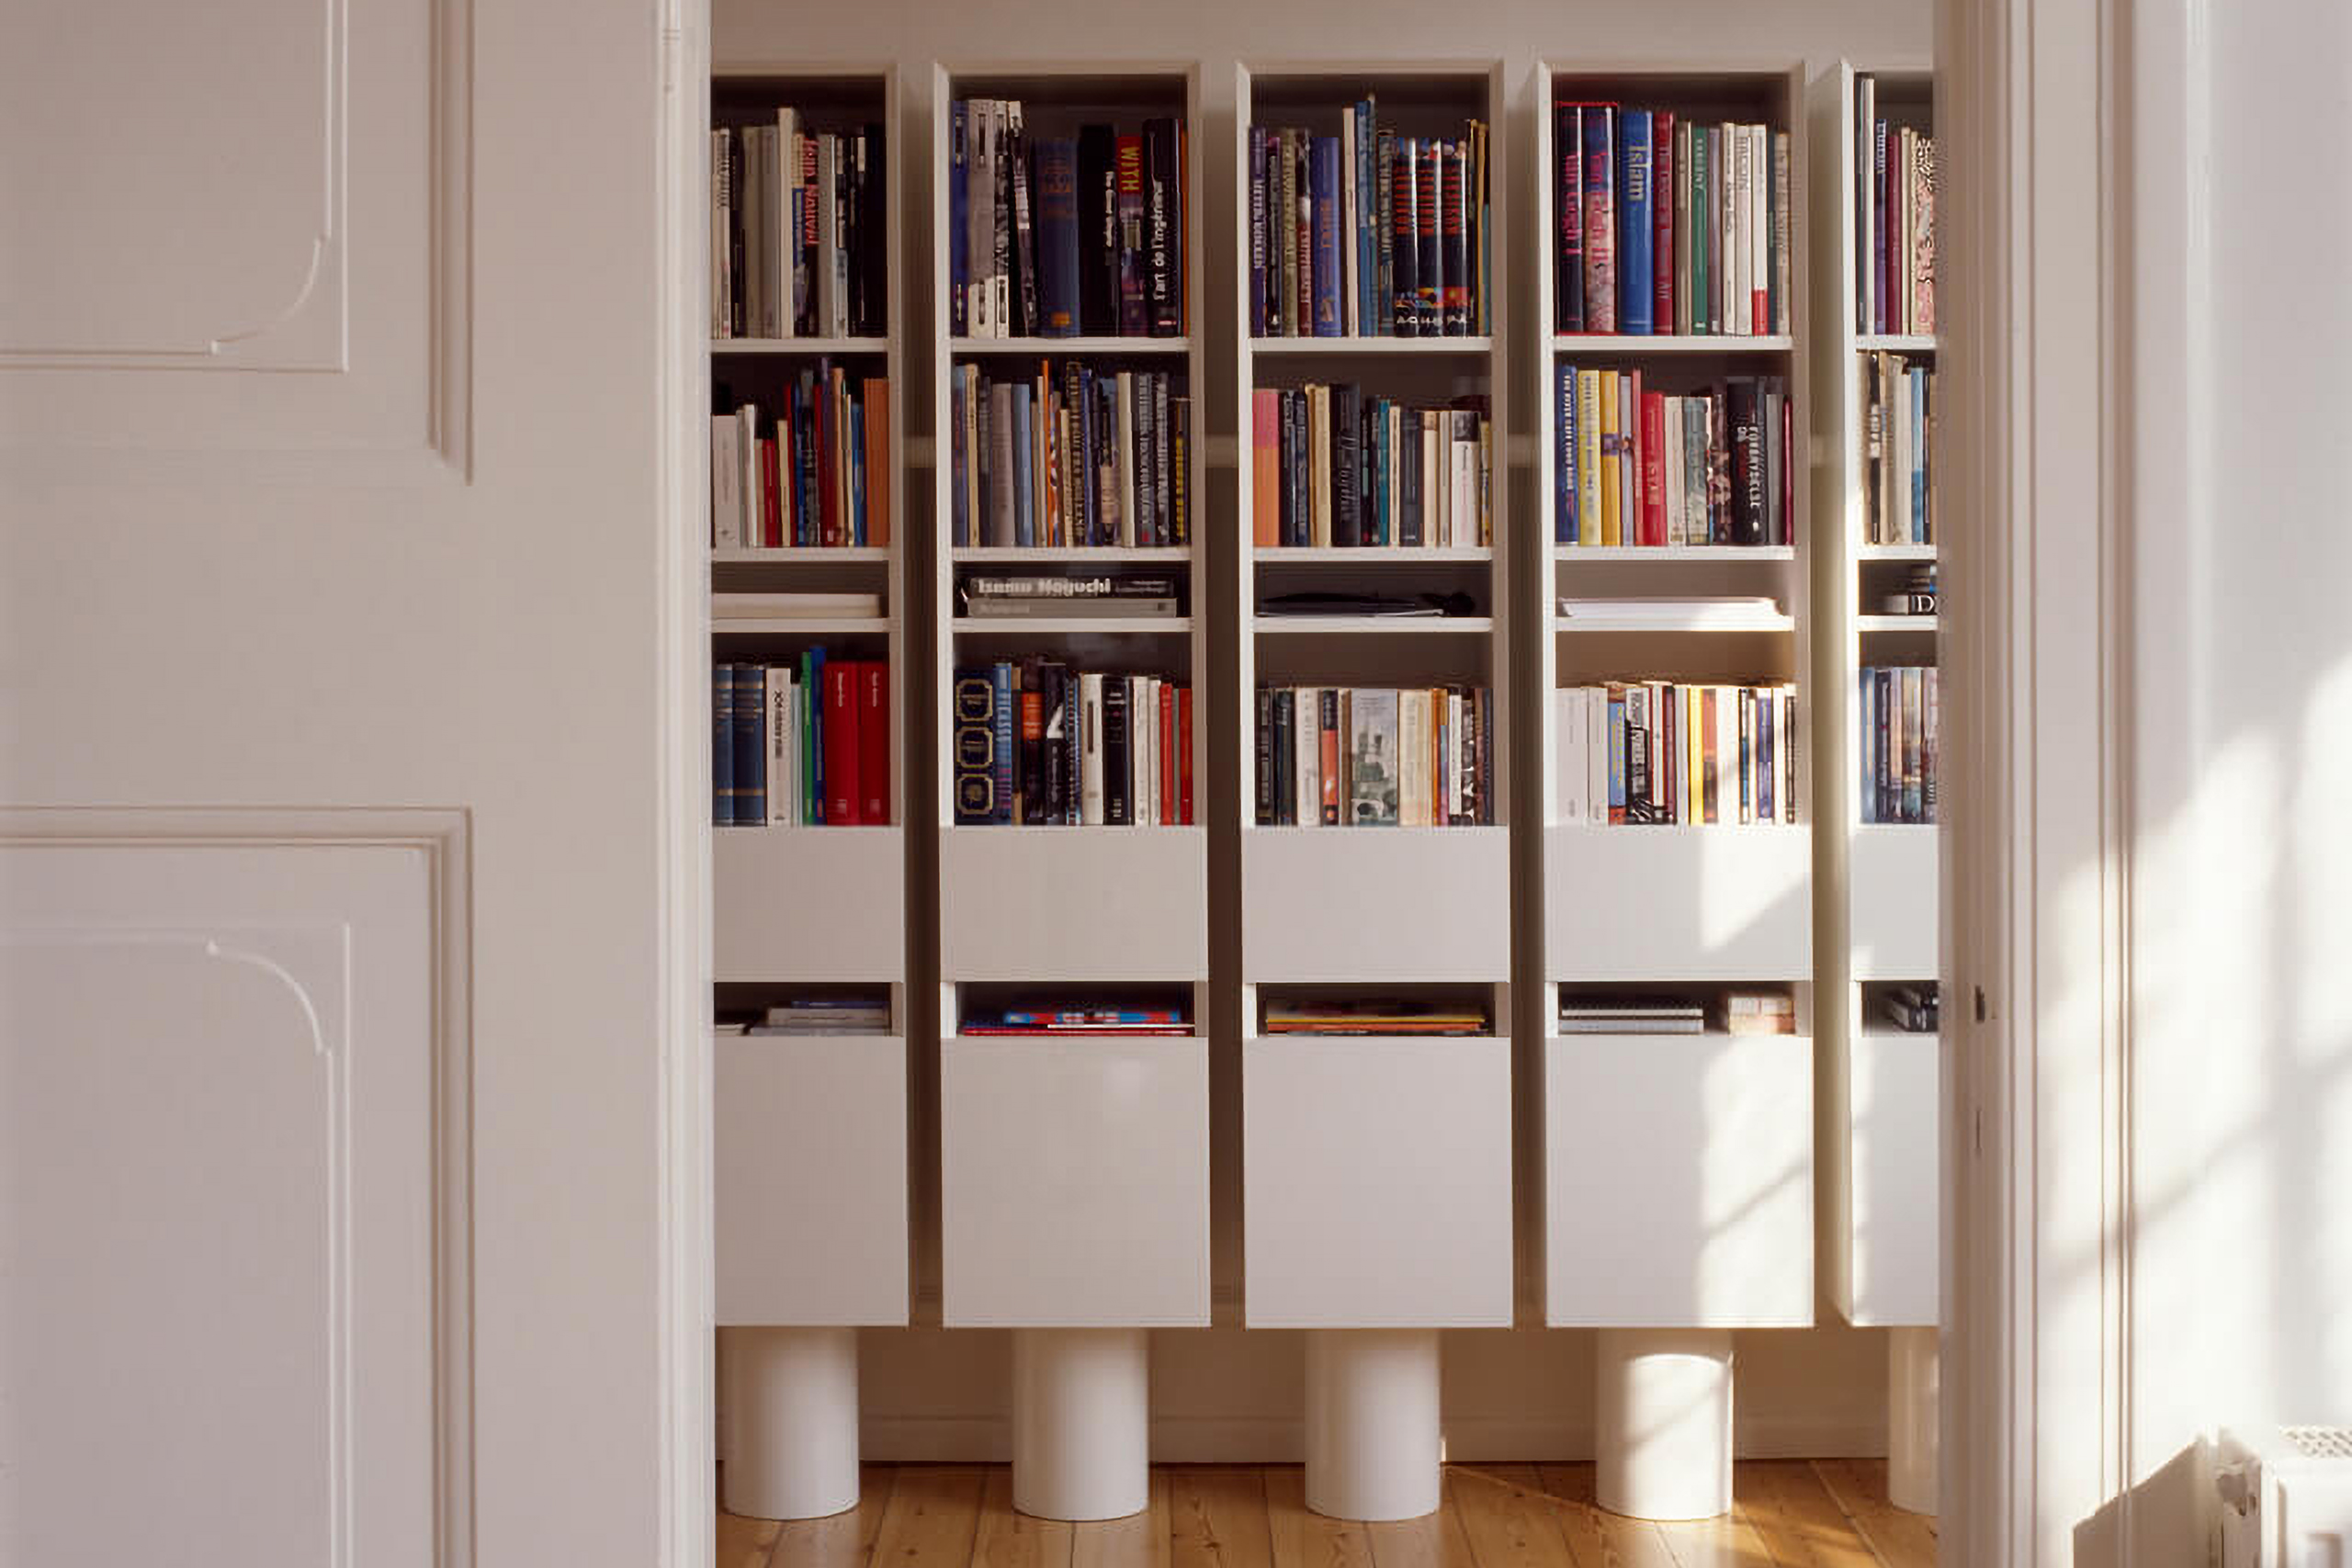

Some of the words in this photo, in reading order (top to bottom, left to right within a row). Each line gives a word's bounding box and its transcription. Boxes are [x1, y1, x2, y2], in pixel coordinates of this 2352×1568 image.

[1121, 146, 1141, 191] WITH
[1628, 145, 1650, 201] Islam
[1037, 578, 1111, 597] Noguchi
